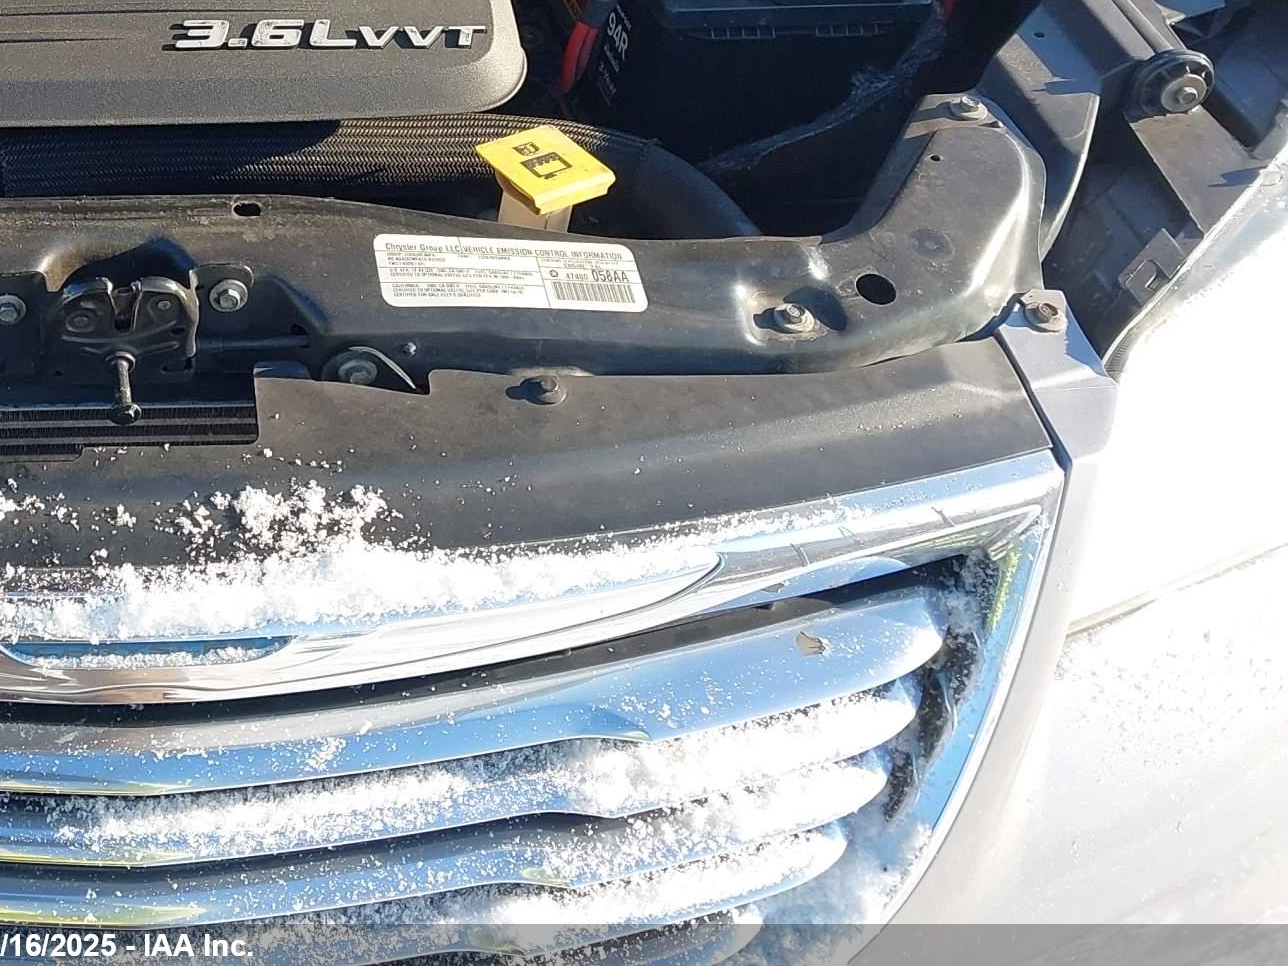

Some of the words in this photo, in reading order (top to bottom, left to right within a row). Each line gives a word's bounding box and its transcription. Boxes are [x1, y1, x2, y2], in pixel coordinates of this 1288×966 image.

[607, 11, 629, 60] 94R
[385, 242, 417, 252] Chrysler
[419, 244, 442, 253] Group
[445, 244, 460, 252] LLC
[462, 245, 494, 254] VEHICLE
[496, 247, 532, 256] EMISSION
[535, 249, 568, 257] CONTROL
[571, 250, 622, 259] INFORMATION
[591, 269, 629, 282] 058AA
